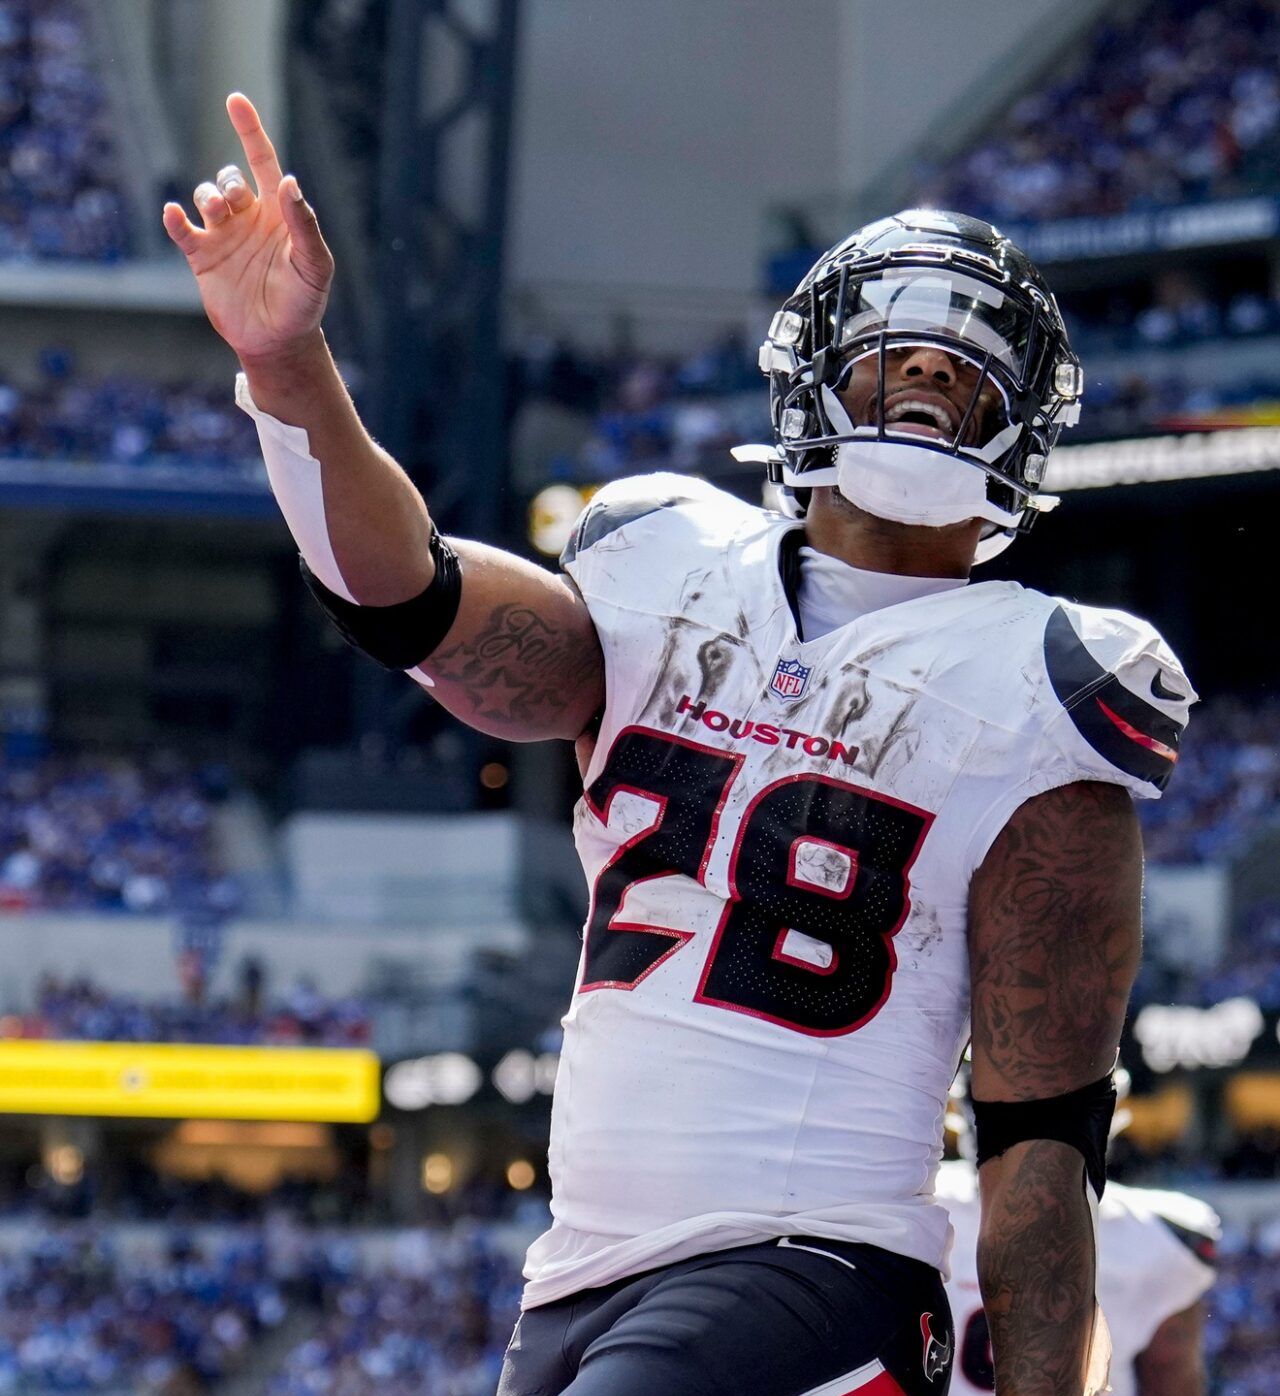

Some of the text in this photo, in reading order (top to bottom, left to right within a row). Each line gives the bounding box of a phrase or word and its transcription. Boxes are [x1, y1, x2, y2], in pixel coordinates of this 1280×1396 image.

[773, 672, 801, 695] NFL
[675, 694, 860, 766] HOUSTON
[579, 724, 936, 1038] 28
